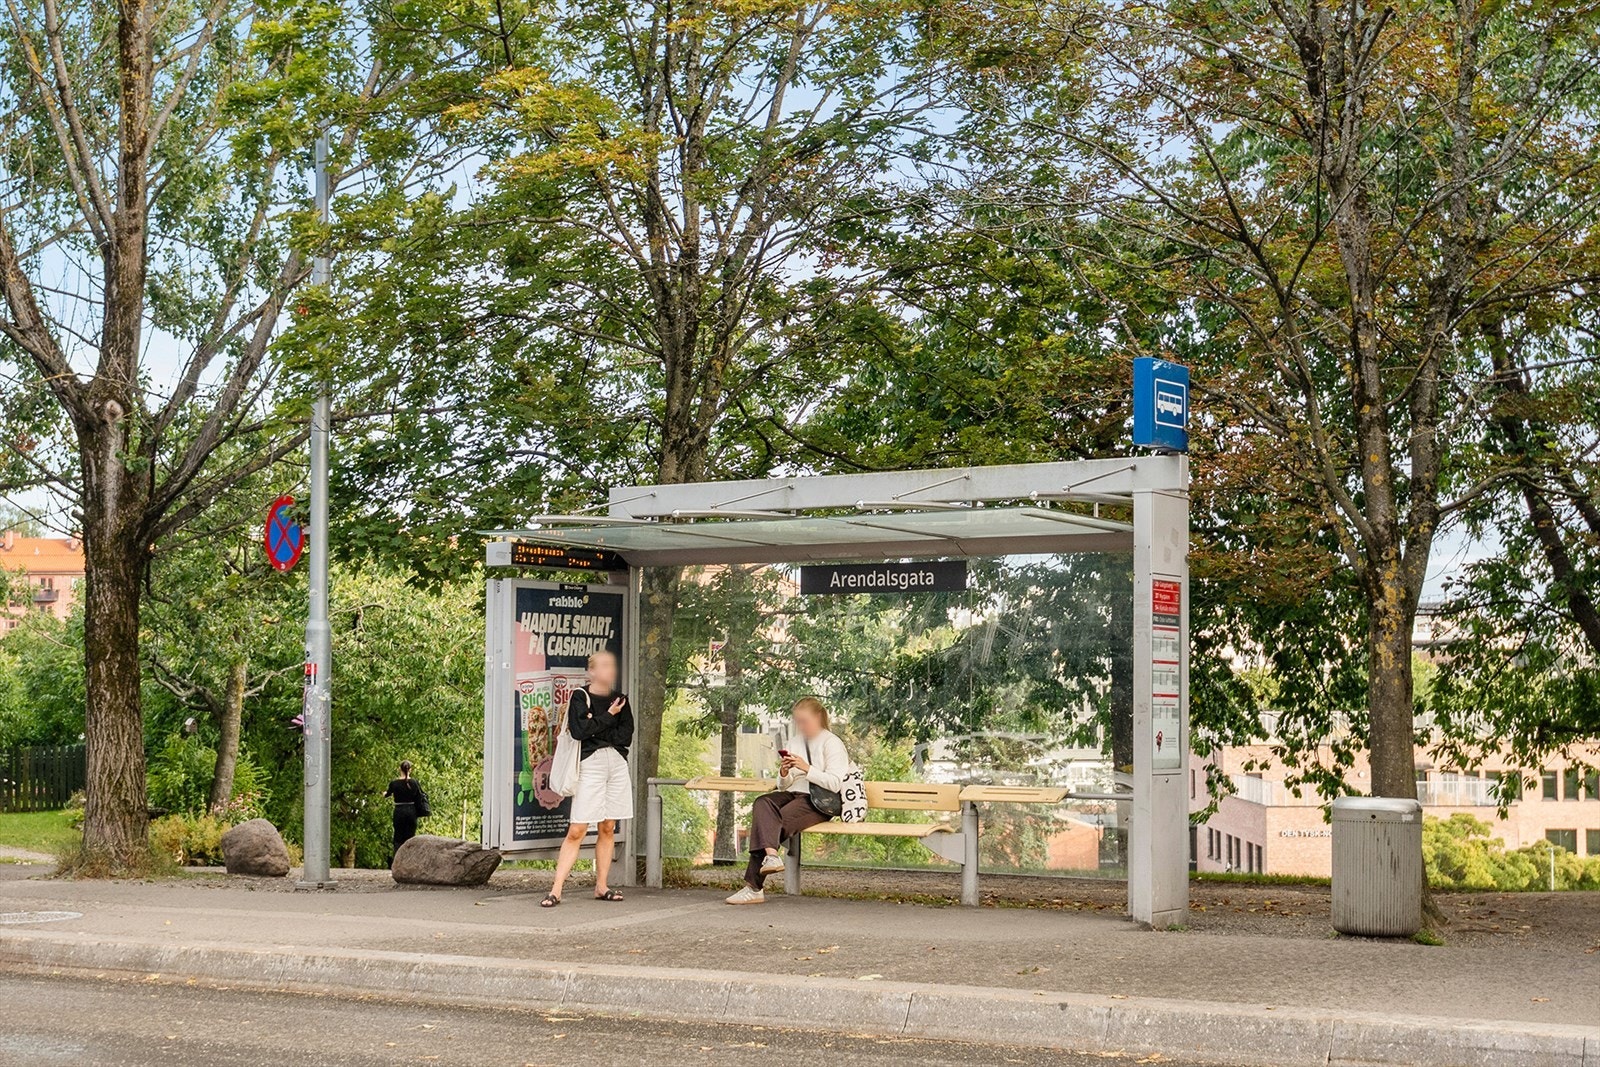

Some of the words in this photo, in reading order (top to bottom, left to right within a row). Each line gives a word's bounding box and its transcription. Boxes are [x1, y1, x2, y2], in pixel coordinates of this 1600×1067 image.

[830, 570, 935, 590] Arendalsgata
[548, 596, 583, 608] rabble
[520, 612, 571, 634] HANDLE
[572, 614, 614, 639] SMART,
[547, 635, 608, 657] CASHBACK
